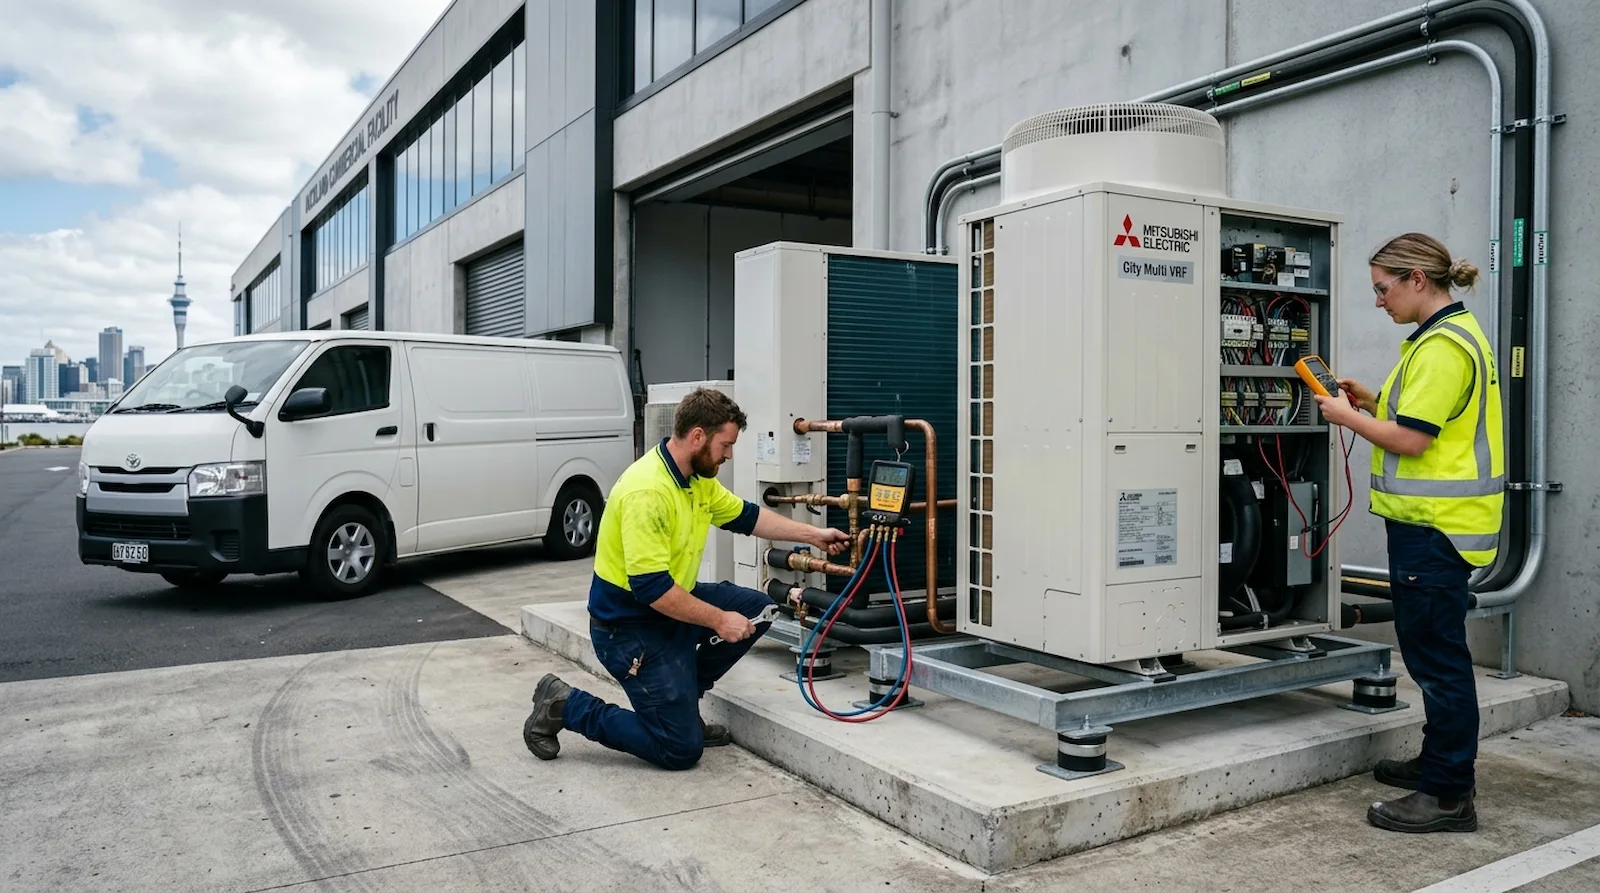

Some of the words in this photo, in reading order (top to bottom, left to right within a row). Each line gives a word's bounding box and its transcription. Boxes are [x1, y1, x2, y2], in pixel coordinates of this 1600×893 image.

[1143, 224, 1199, 242] MITSUBISHI
[1143, 236, 1190, 253] ELECTRIC
[1144, 263, 1167, 277] Multi
[1169, 265, 1188, 279] VRF
